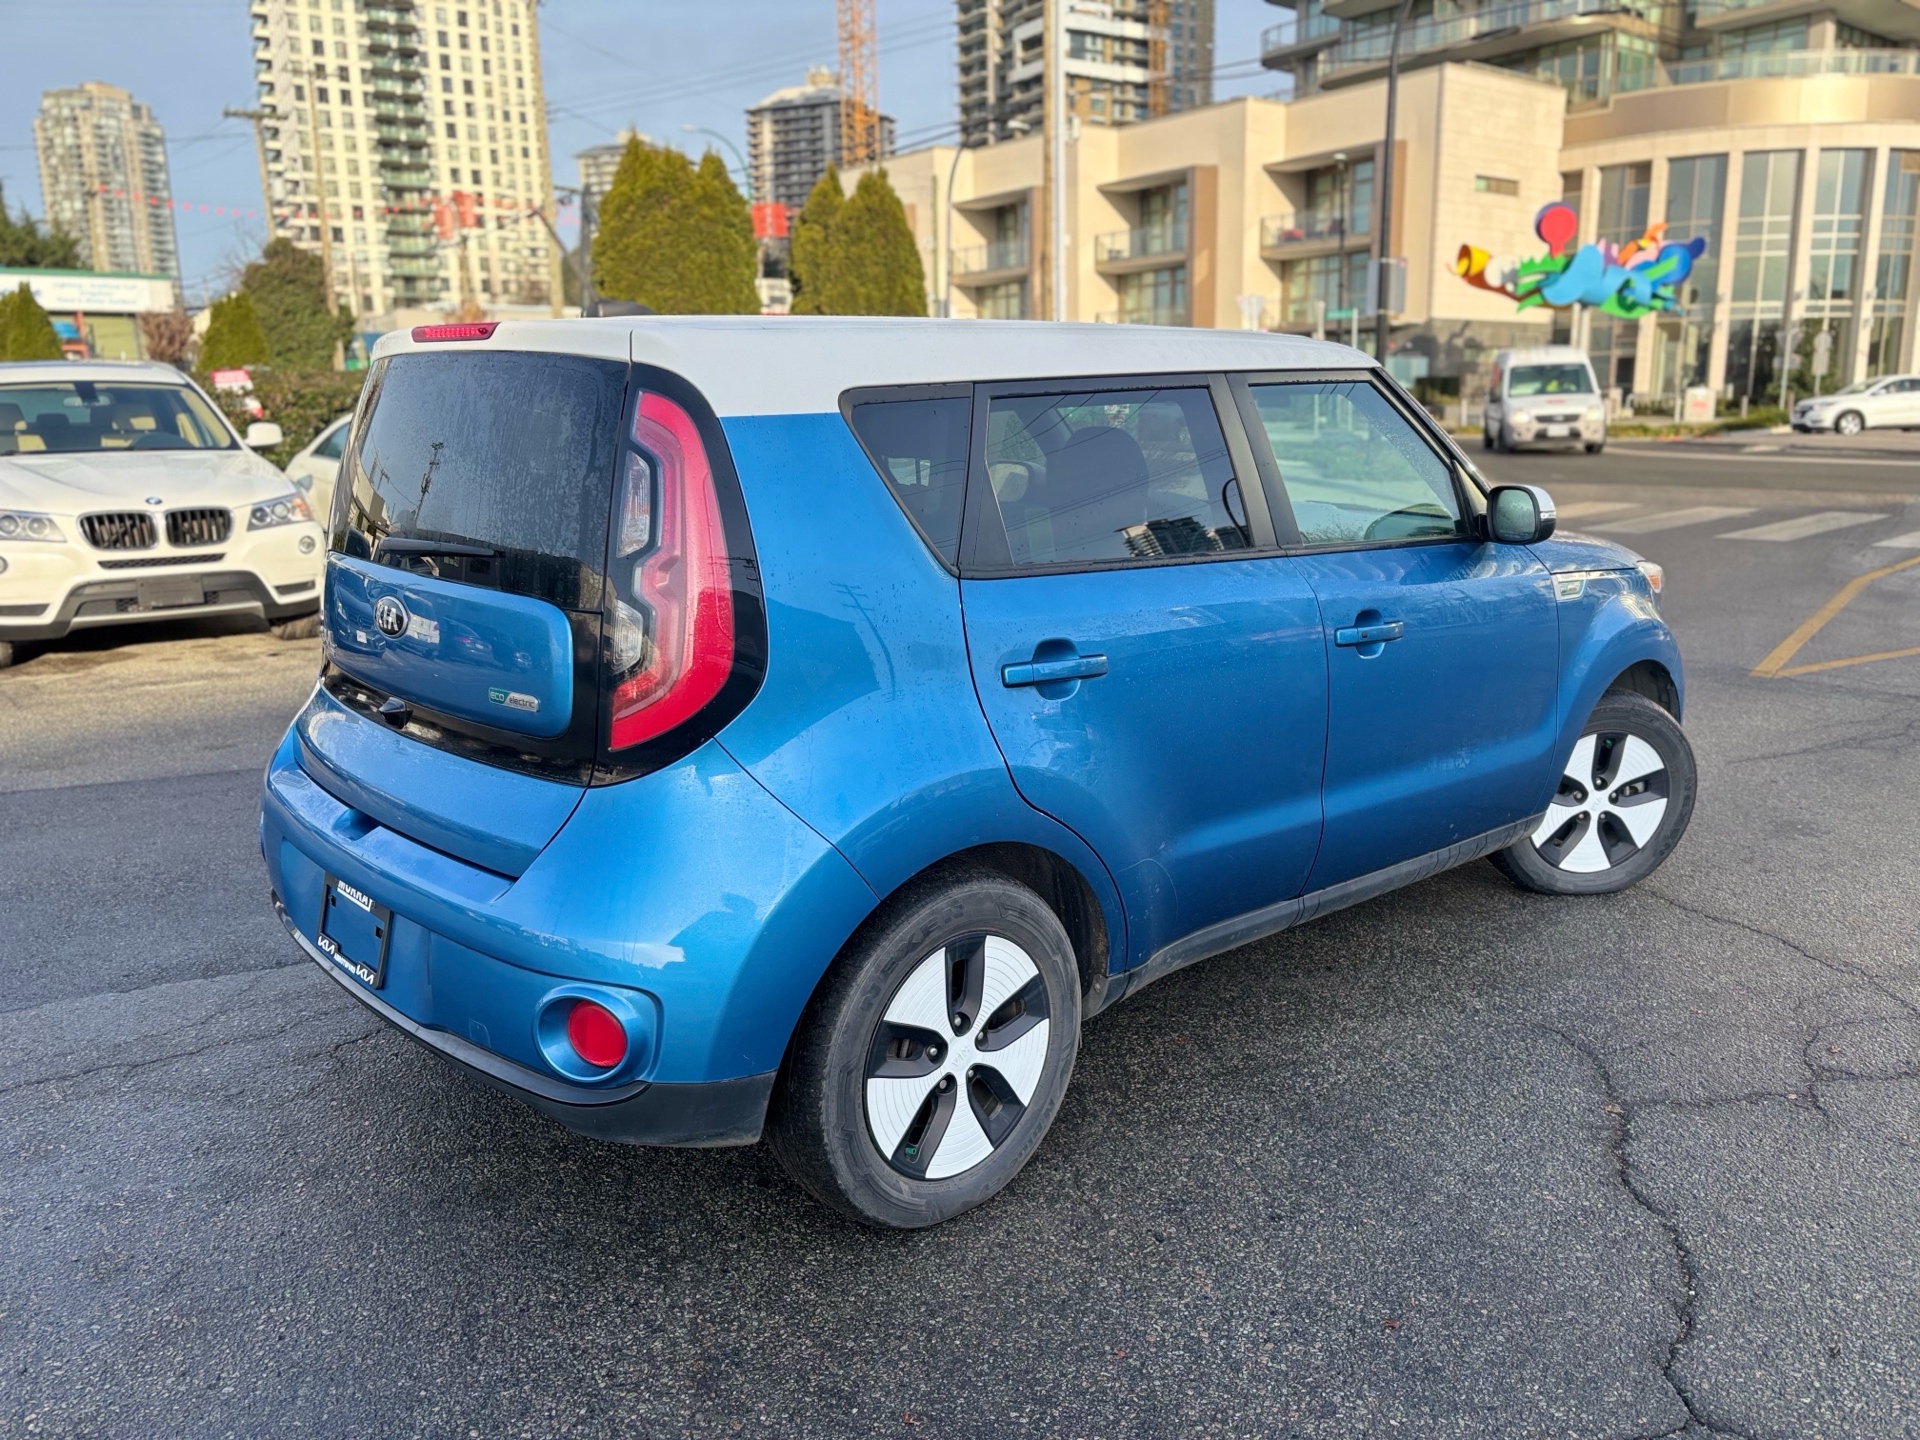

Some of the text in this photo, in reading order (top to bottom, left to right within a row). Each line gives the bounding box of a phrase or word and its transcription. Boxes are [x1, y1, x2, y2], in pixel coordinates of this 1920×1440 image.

[376, 601, 399, 631] KIA
[490, 691, 535, 709] ECO electric
[318, 935, 335, 955] KIA
[860, 902, 965, 1012] NEXEN
[356, 964, 375, 985] KIA
